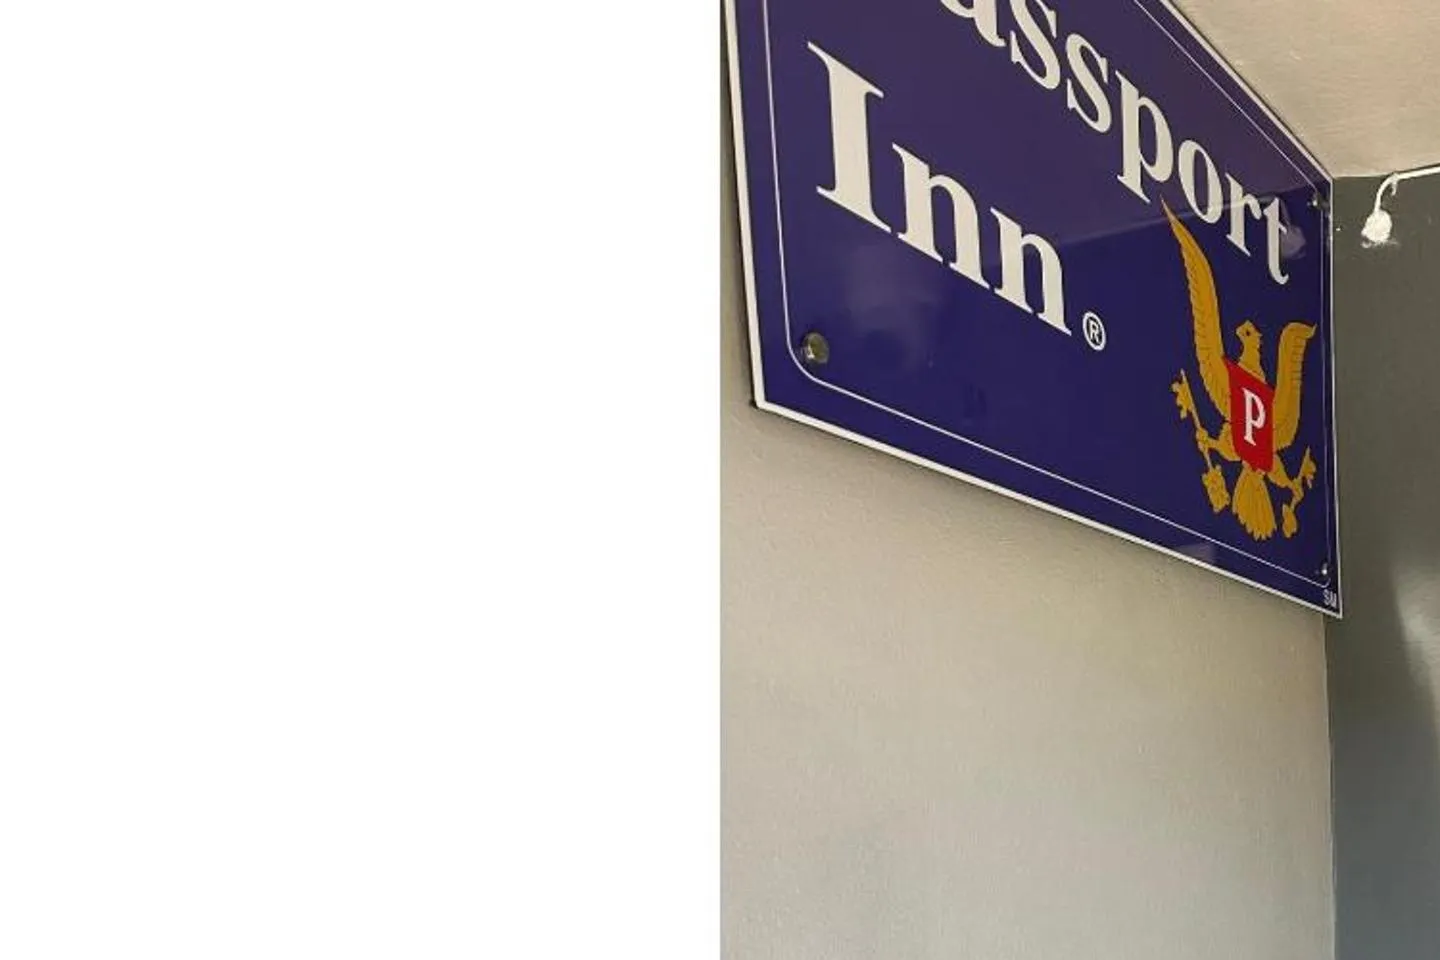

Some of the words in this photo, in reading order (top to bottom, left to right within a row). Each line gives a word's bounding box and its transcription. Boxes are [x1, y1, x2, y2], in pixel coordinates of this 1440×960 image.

[808, 41, 1072, 336] Inn
[938, 0, 1289, 285] ssport
[1243, 386, 1266, 446] P
